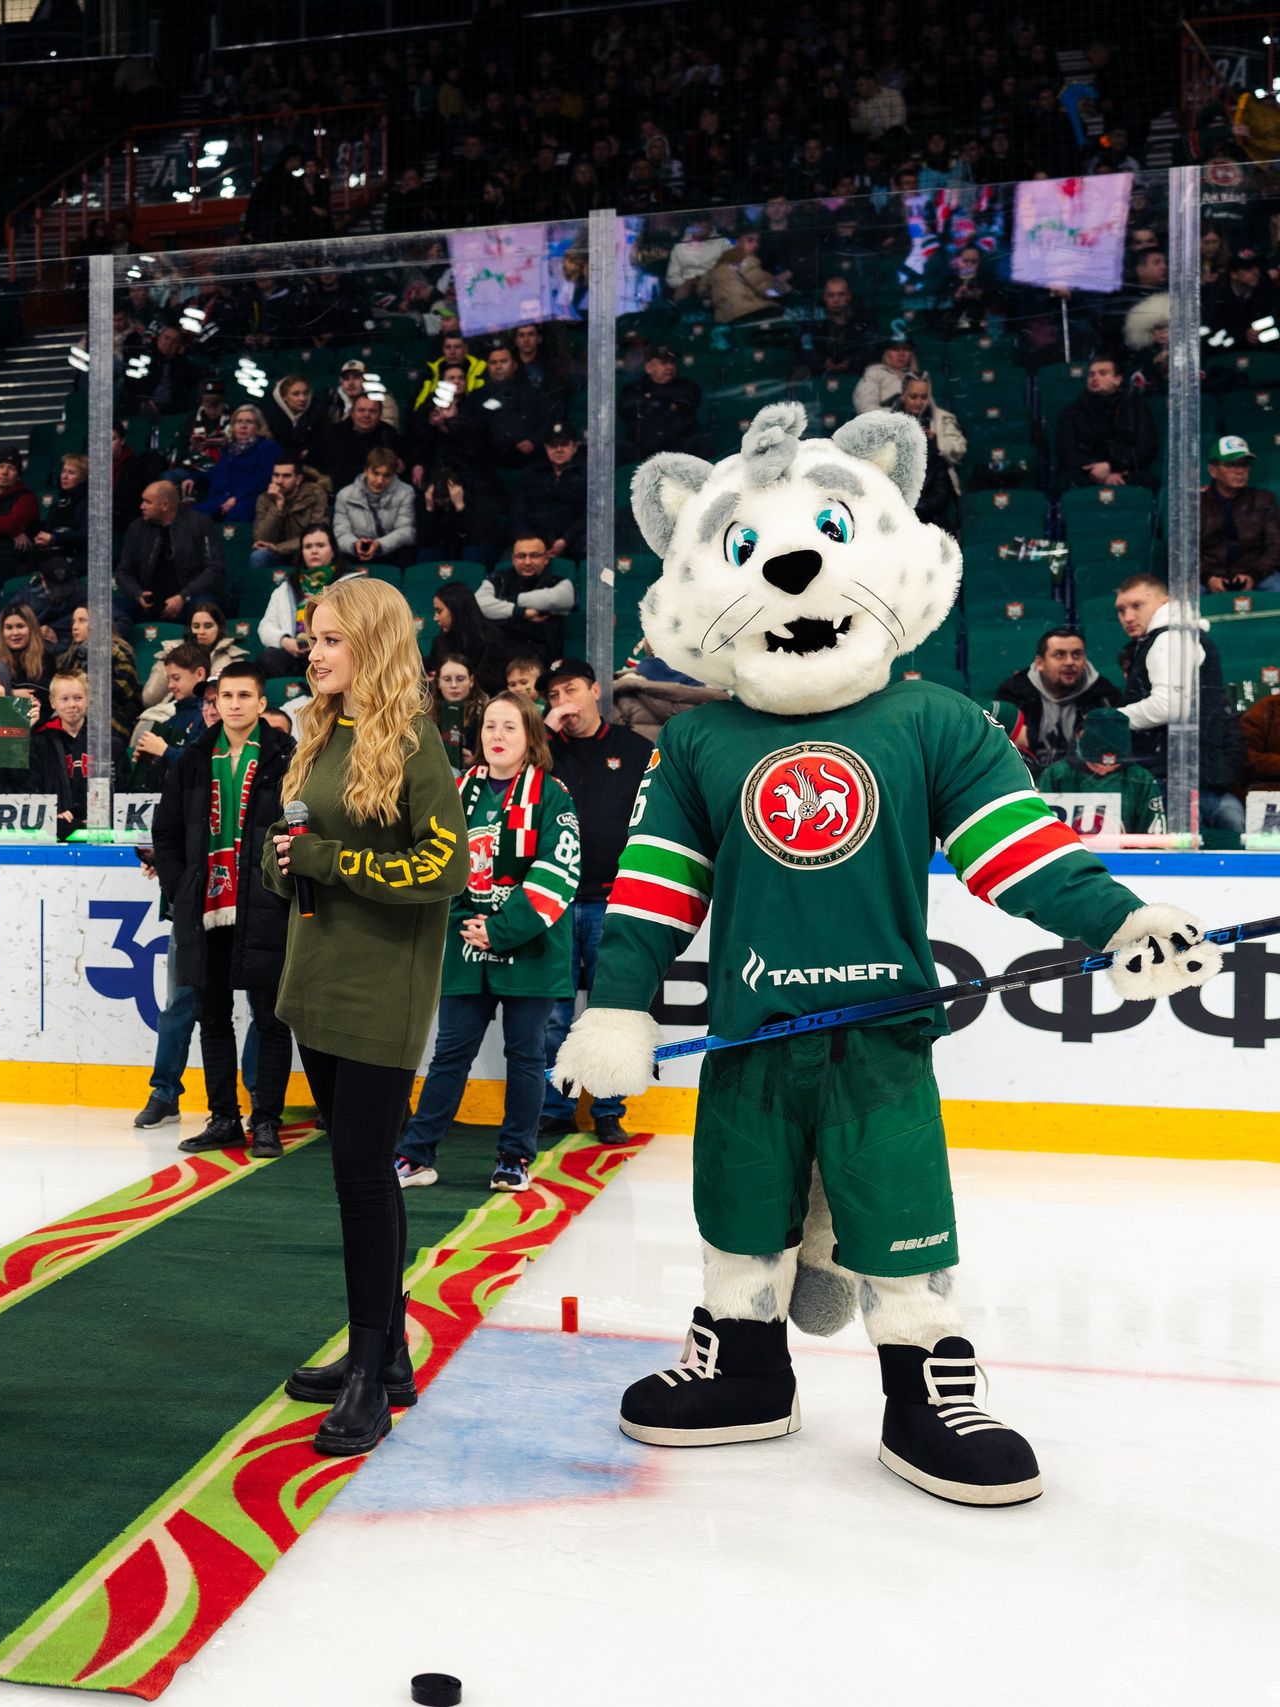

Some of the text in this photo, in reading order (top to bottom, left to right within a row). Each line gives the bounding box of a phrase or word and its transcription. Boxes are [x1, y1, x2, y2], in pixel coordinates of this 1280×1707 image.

[554, 830, 581, 877] 82
[779, 845, 852, 865] ТАТАРСТАН
[767, 962, 903, 986] TATNEFT
[889, 1231, 950, 1252] BAUER
